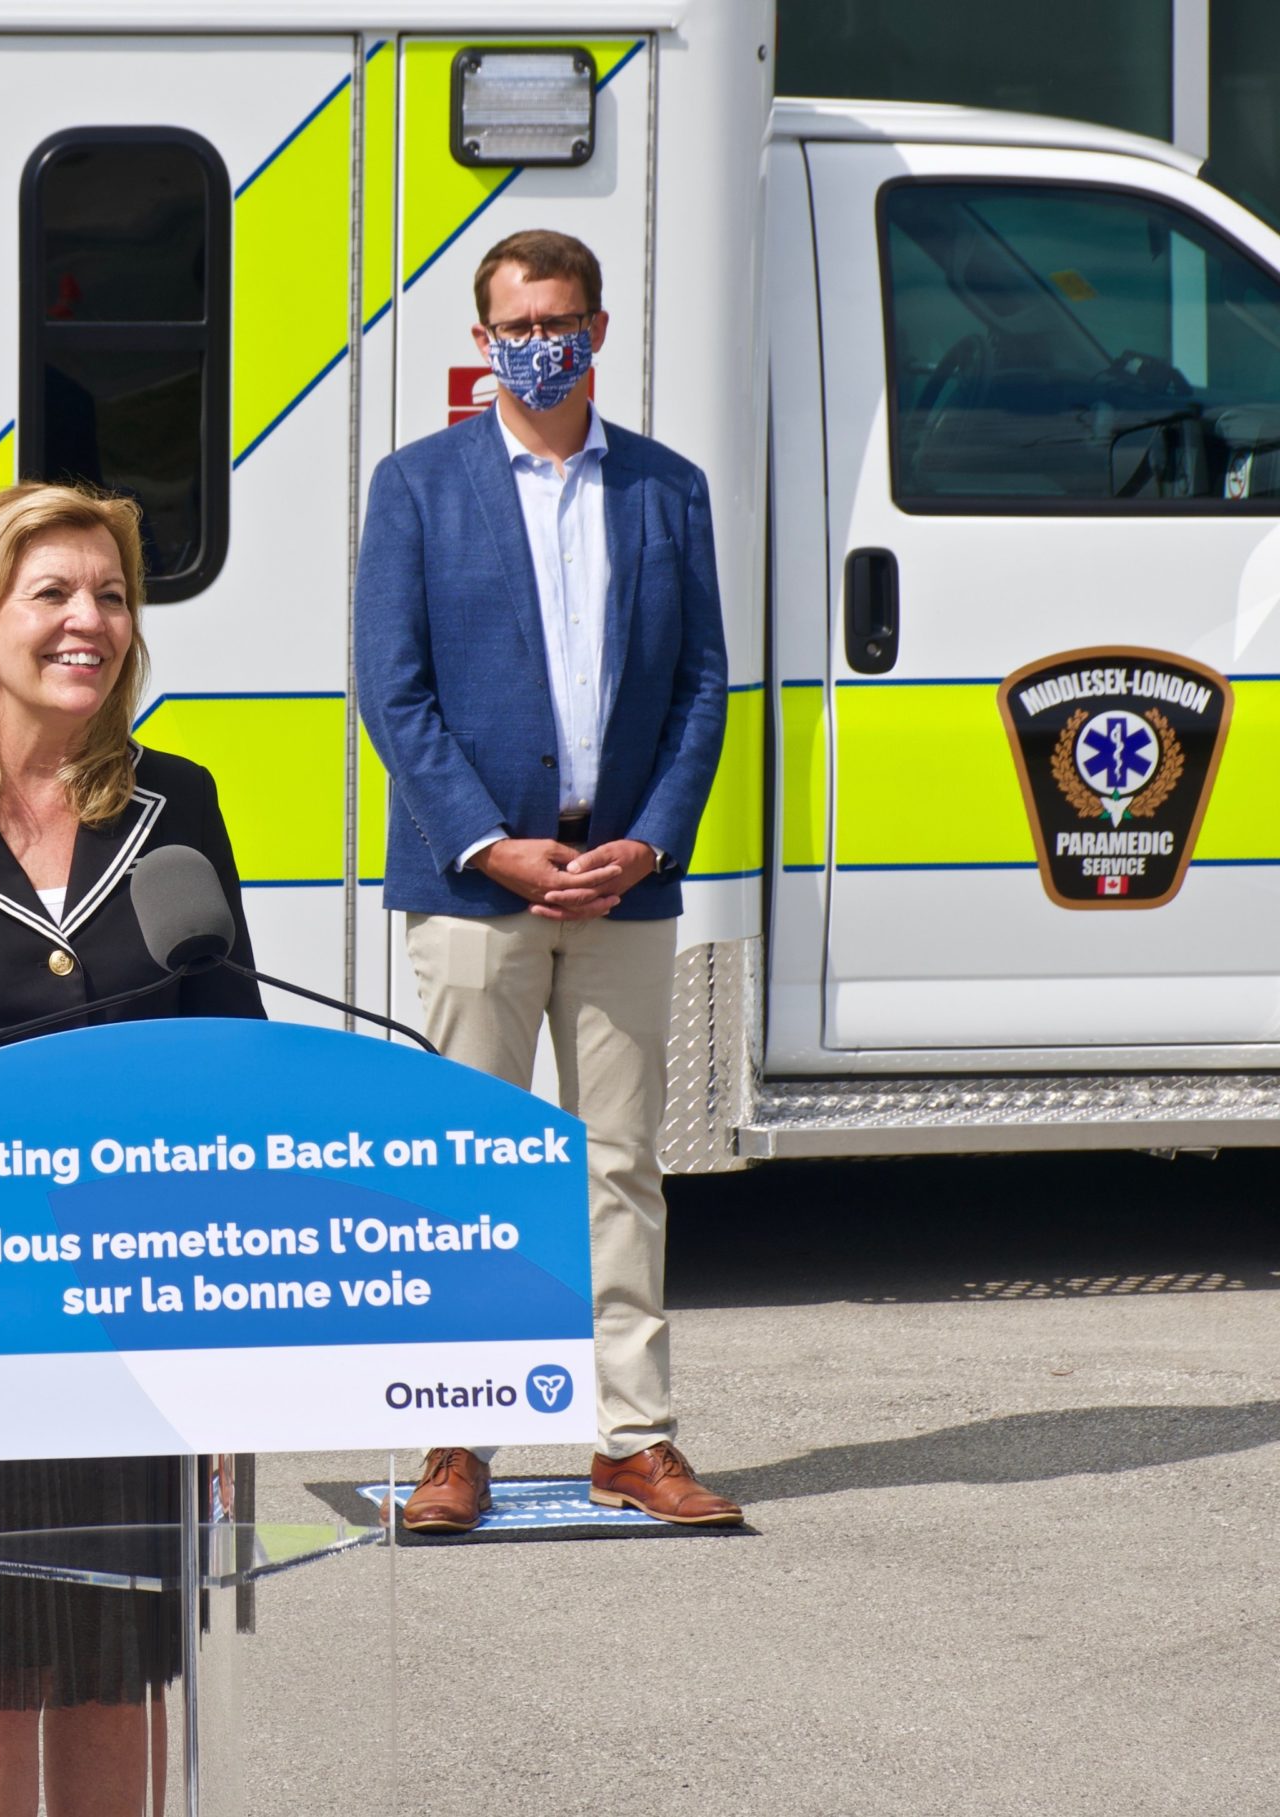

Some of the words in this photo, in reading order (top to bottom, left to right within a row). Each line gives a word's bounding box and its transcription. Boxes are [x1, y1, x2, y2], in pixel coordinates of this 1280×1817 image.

[1019, 668, 1213, 716] MIDDLESEX-LONDON
[1056, 831, 1174, 856] PARAMEDIC
[1082, 857, 1146, 876] SERVICE
[90, 1135, 256, 1174] Ontario
[267, 1132, 375, 1169] Back
[383, 1139, 438, 1167] on
[446, 1127, 570, 1165] Track
[92, 1222, 320, 1260] remettons
[63, 1286, 132, 1315] sur
[141, 1277, 184, 1313] la
[194, 1276, 332, 1312] bonne
[340, 1271, 432, 1307] voie
[385, 1379, 517, 1410] Ontario
